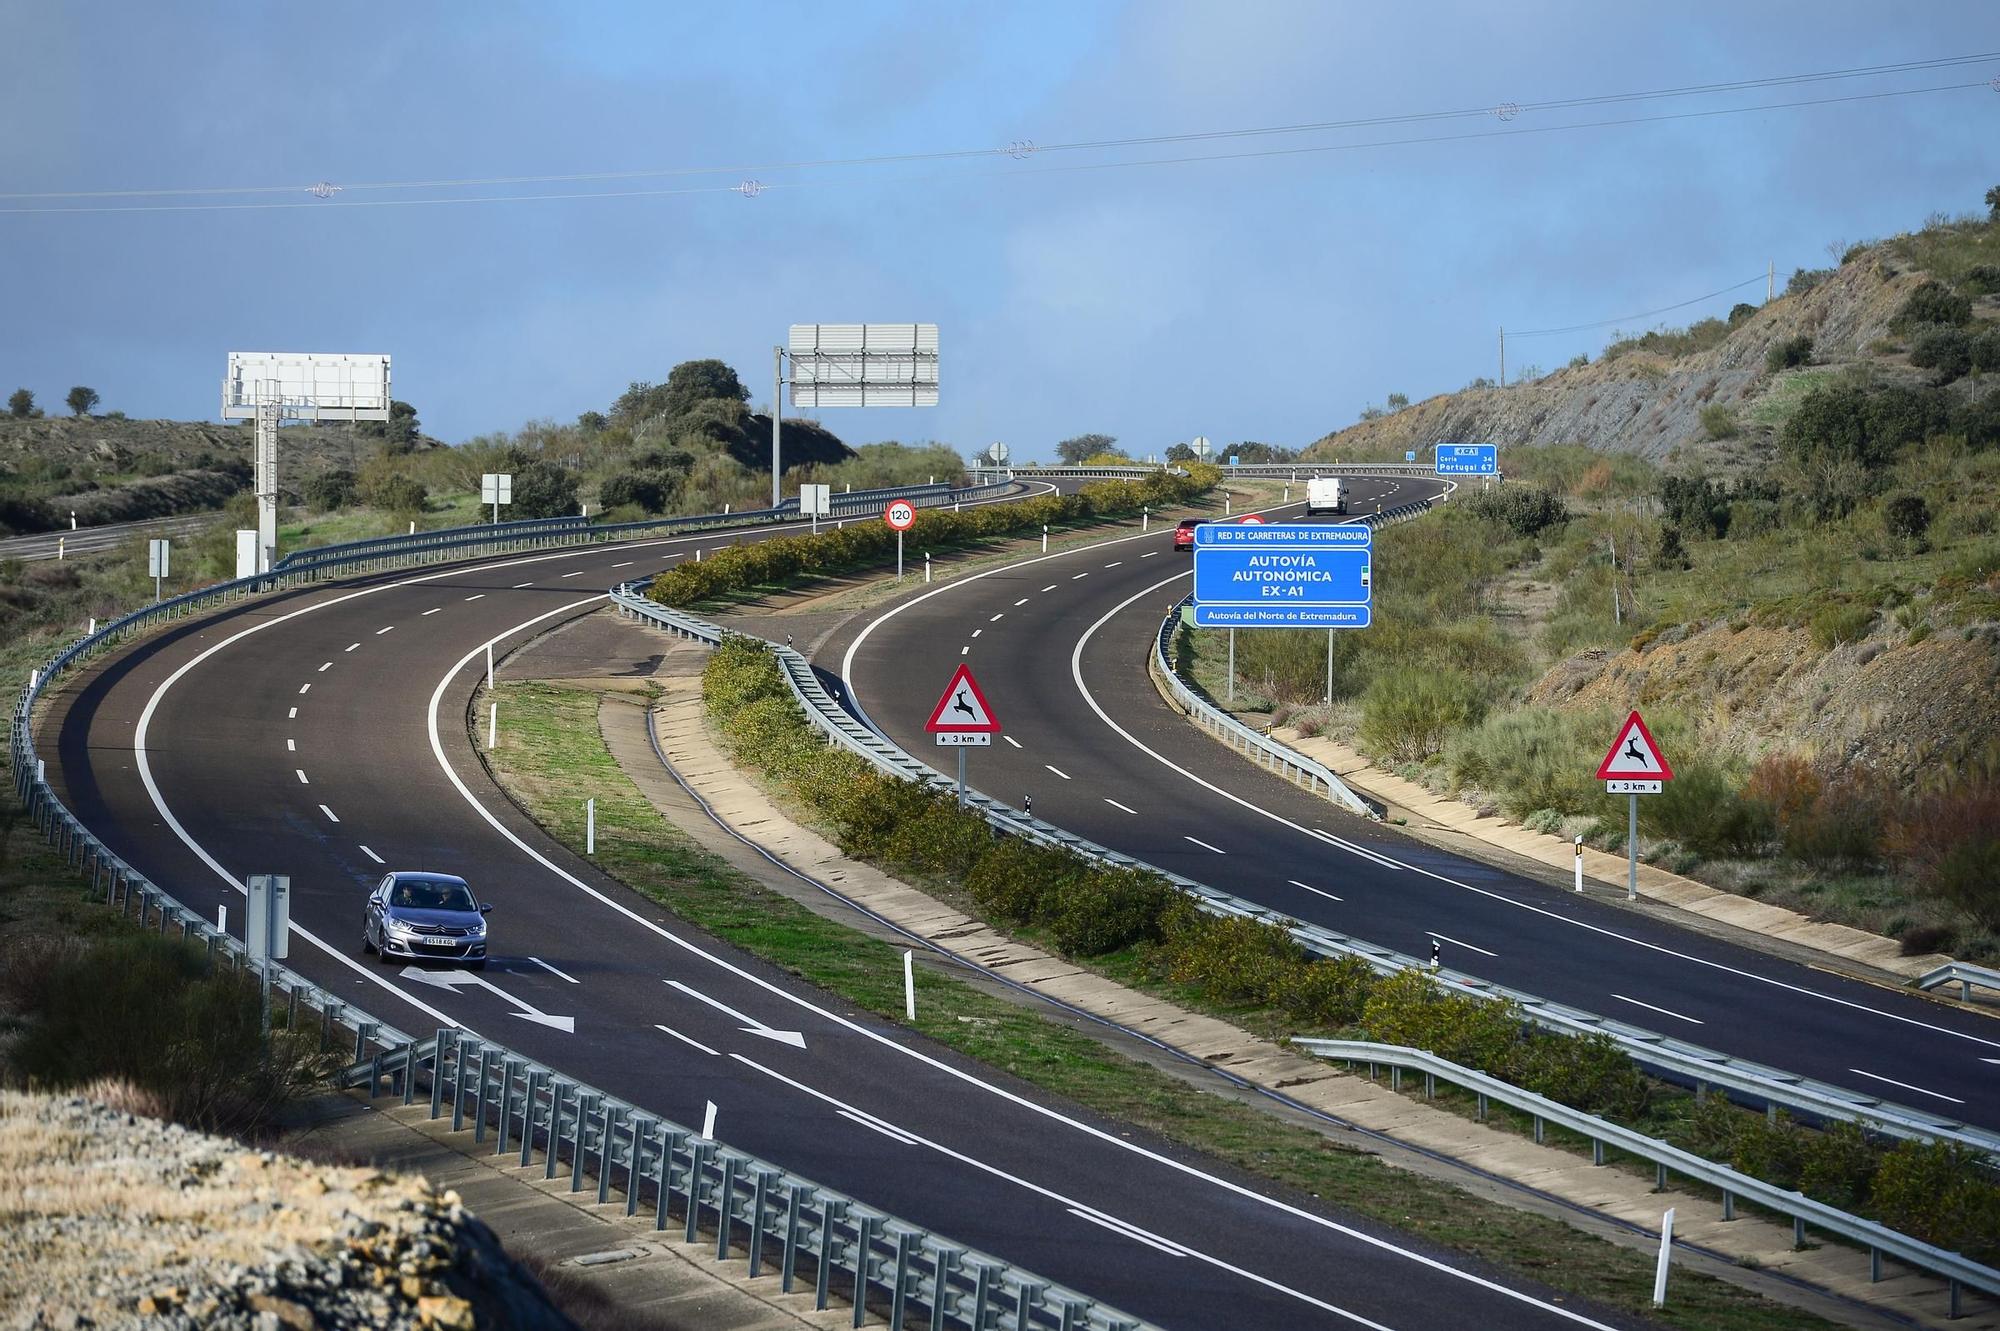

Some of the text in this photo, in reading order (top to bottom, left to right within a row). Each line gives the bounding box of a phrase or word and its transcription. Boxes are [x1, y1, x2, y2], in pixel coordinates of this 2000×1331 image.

[1440, 464, 1477, 472] Portugal
[891, 510, 910, 520] 120
[1217, 531, 1368, 541] RED DE CARRETERAS DE EXTREMADURA
[1249, 554, 1316, 567] AUTOVÍA
[1232, 568, 1332, 582] AUTONÓMICA
[1262, 586, 1304, 597] EX-A1
[1207, 611, 1357, 620] Autovía del Norte de Extremadura
[952, 735, 975, 743] 3 km
[1623, 782, 1646, 790] 3 km
